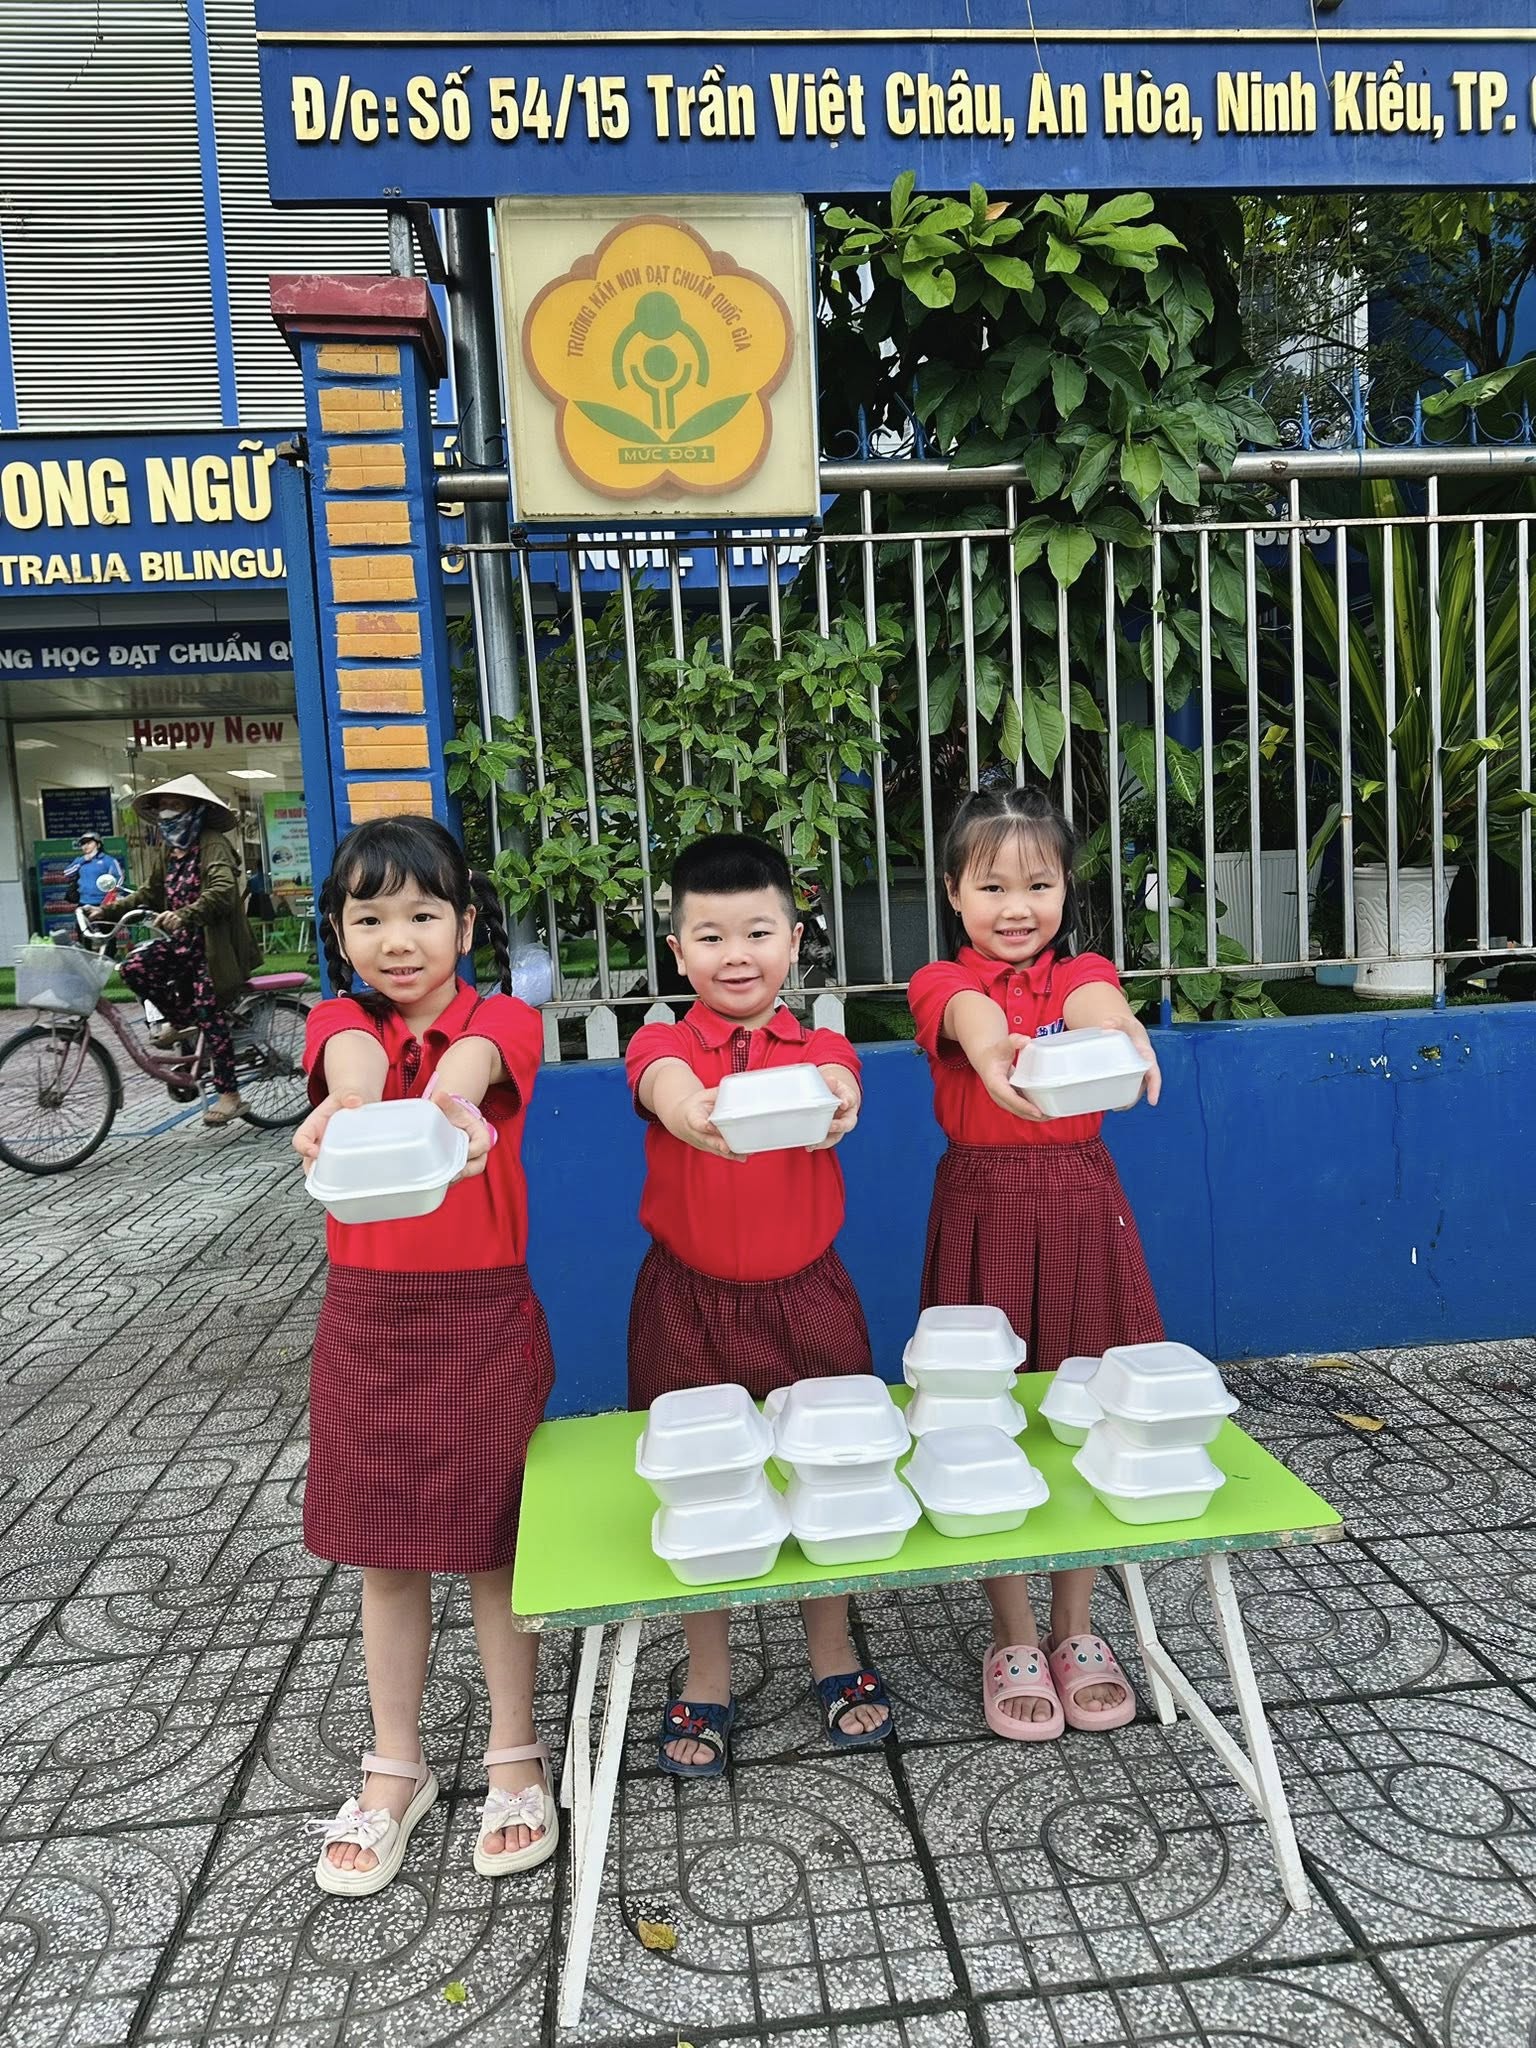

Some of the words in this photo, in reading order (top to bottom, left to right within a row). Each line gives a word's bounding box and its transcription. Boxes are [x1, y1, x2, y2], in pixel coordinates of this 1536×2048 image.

[291, 75, 398, 142] Đ/c:
[407, 64, 473, 141] Số
[489, 74, 631, 141] 54/15
[647, 64, 756, 137] Trần
[769, 67, 867, 149] Việt
[886, 68, 1014, 143] Châu,
[1027, 72, 1088, 134] An
[1103, 70, 1203, 142] Hòa,
[1216, 71, 1316, 134] Ninh
[1334, 60, 1445, 140] Kiều,
[1452, 71, 1517, 132] TP.
[567, 304, 598, 357] TRƯỜNG
[616, 266, 642, 291] NON
[645, 264, 671, 286] ĐẠT
[711, 292, 743, 326] QUỐC
[701, 448, 710, 460] 1
[0, 458, 131, 529] ONG
[145, 438, 276, 524] NGỮ
[0, 552, 131, 586] TRALIA
[140, 547, 287, 584] BILINGU
[41, 646, 100, 673] HỌC
[109, 645, 161, 670] ĐẠT
[169, 632, 262, 664] CHUẨN
[268, 640, 293, 662] Q
[133, 719, 215, 749] Happy
[224, 716, 283, 744] New
